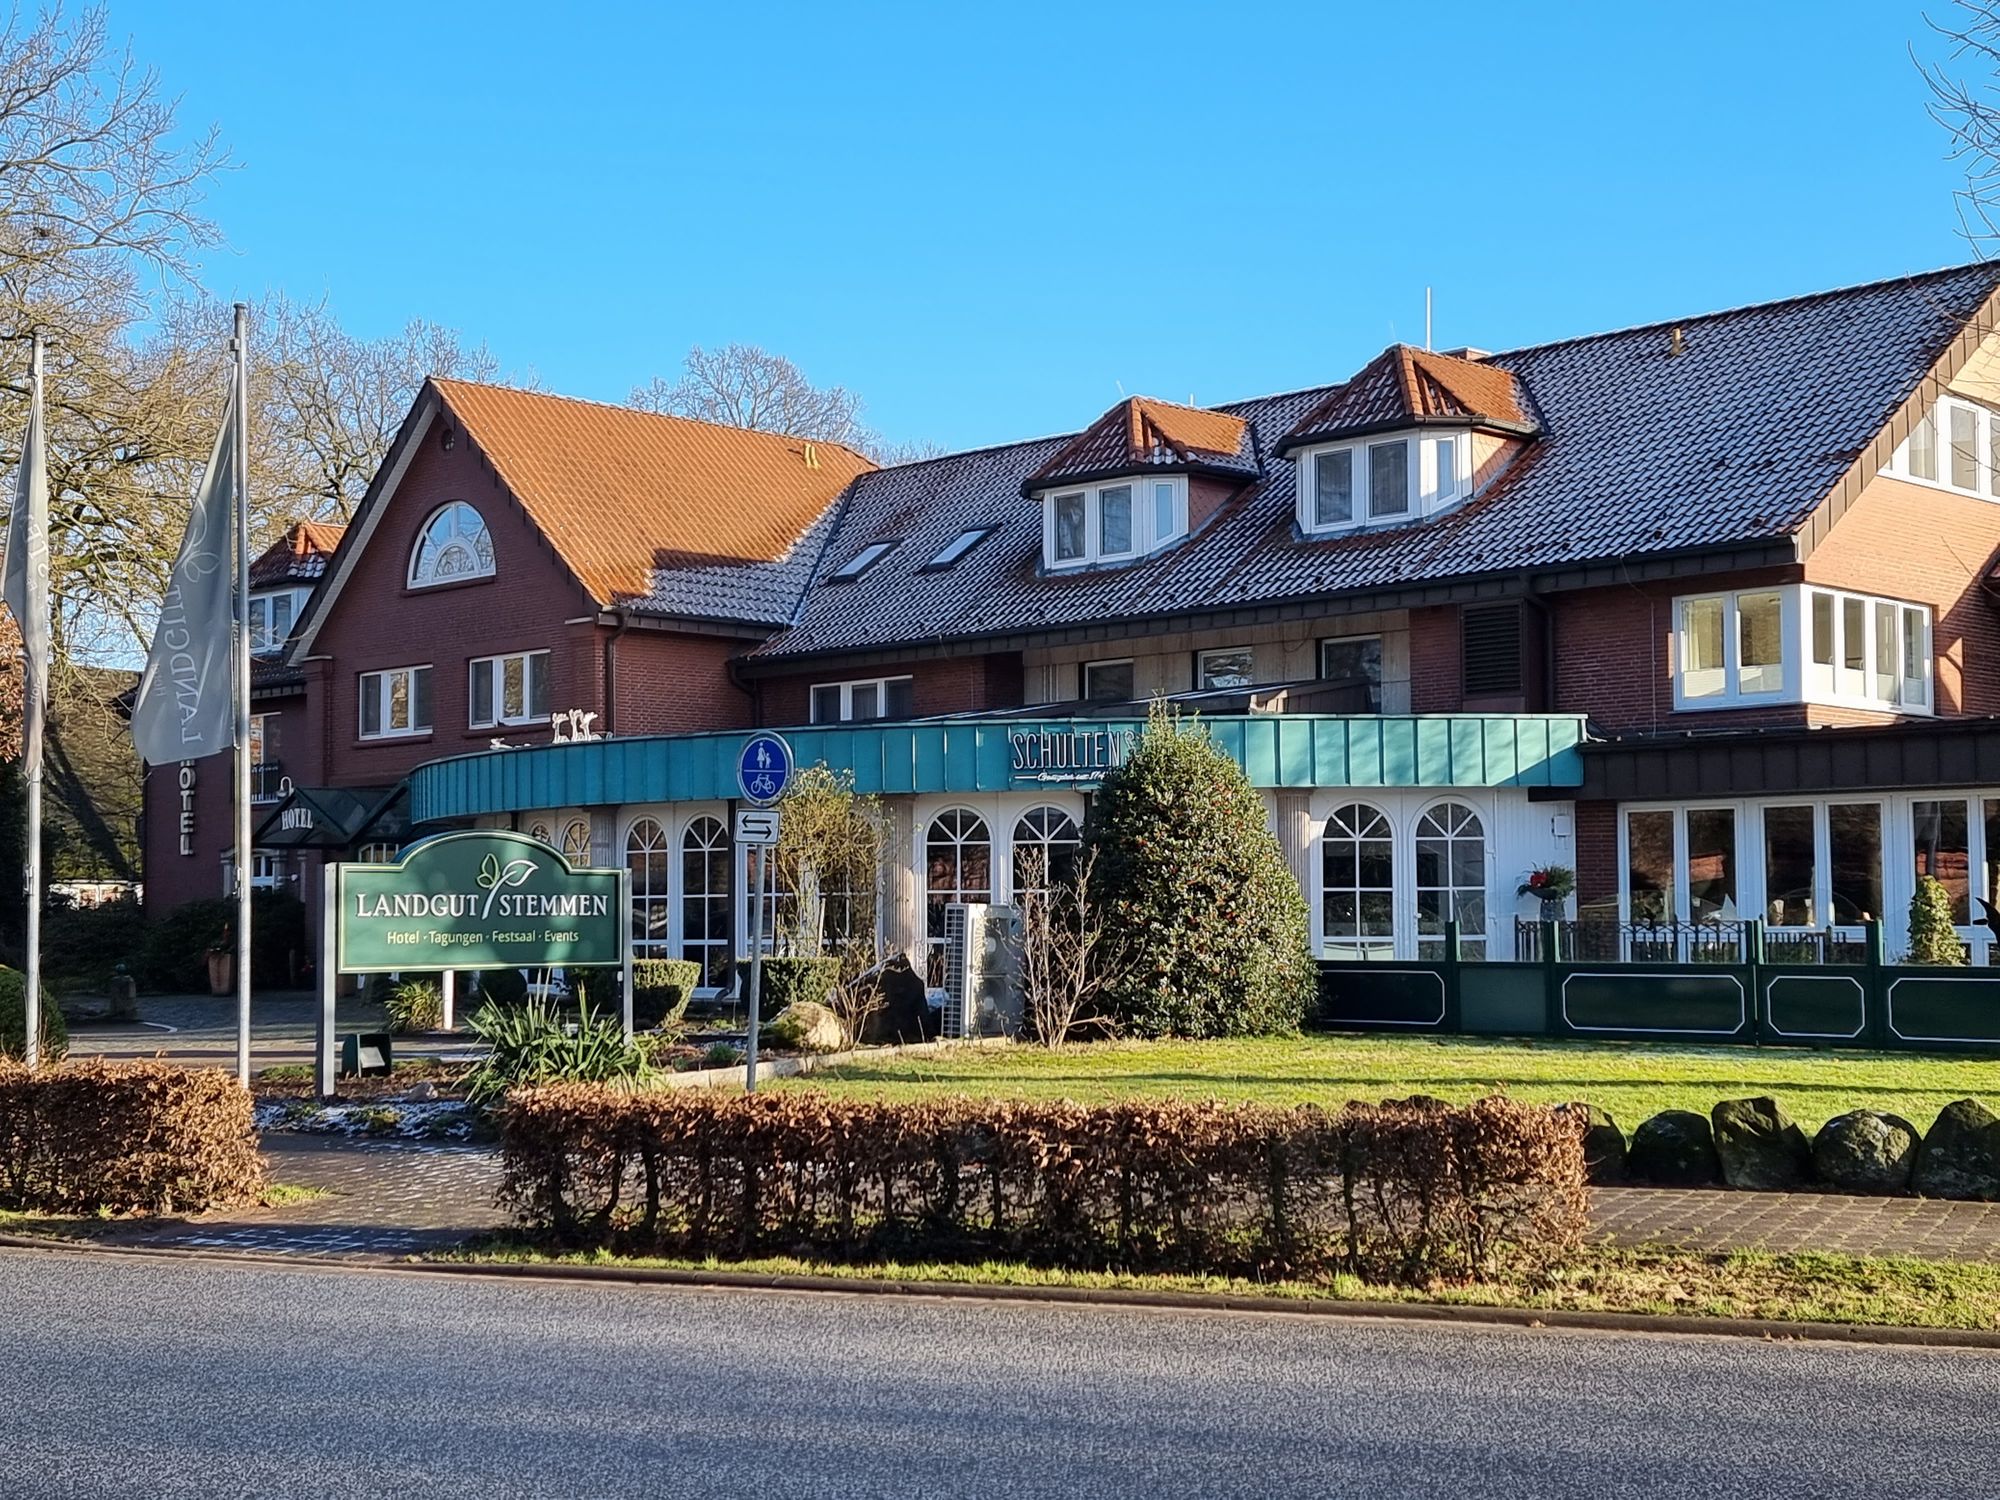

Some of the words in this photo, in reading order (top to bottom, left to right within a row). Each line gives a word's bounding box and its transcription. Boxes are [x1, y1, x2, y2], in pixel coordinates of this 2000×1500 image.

[178, 760, 197, 856] OTEL
[281, 807, 313, 831] HOTEL
[356, 893, 479, 918] LANDGUT
[498, 893, 608, 917] STEMMEN
[387, 930, 420, 945] Hotel
[428, 931, 483, 948] Tagungen
[492, 930, 536, 944] Festsaal
[544, 930, 579, 943] Events
